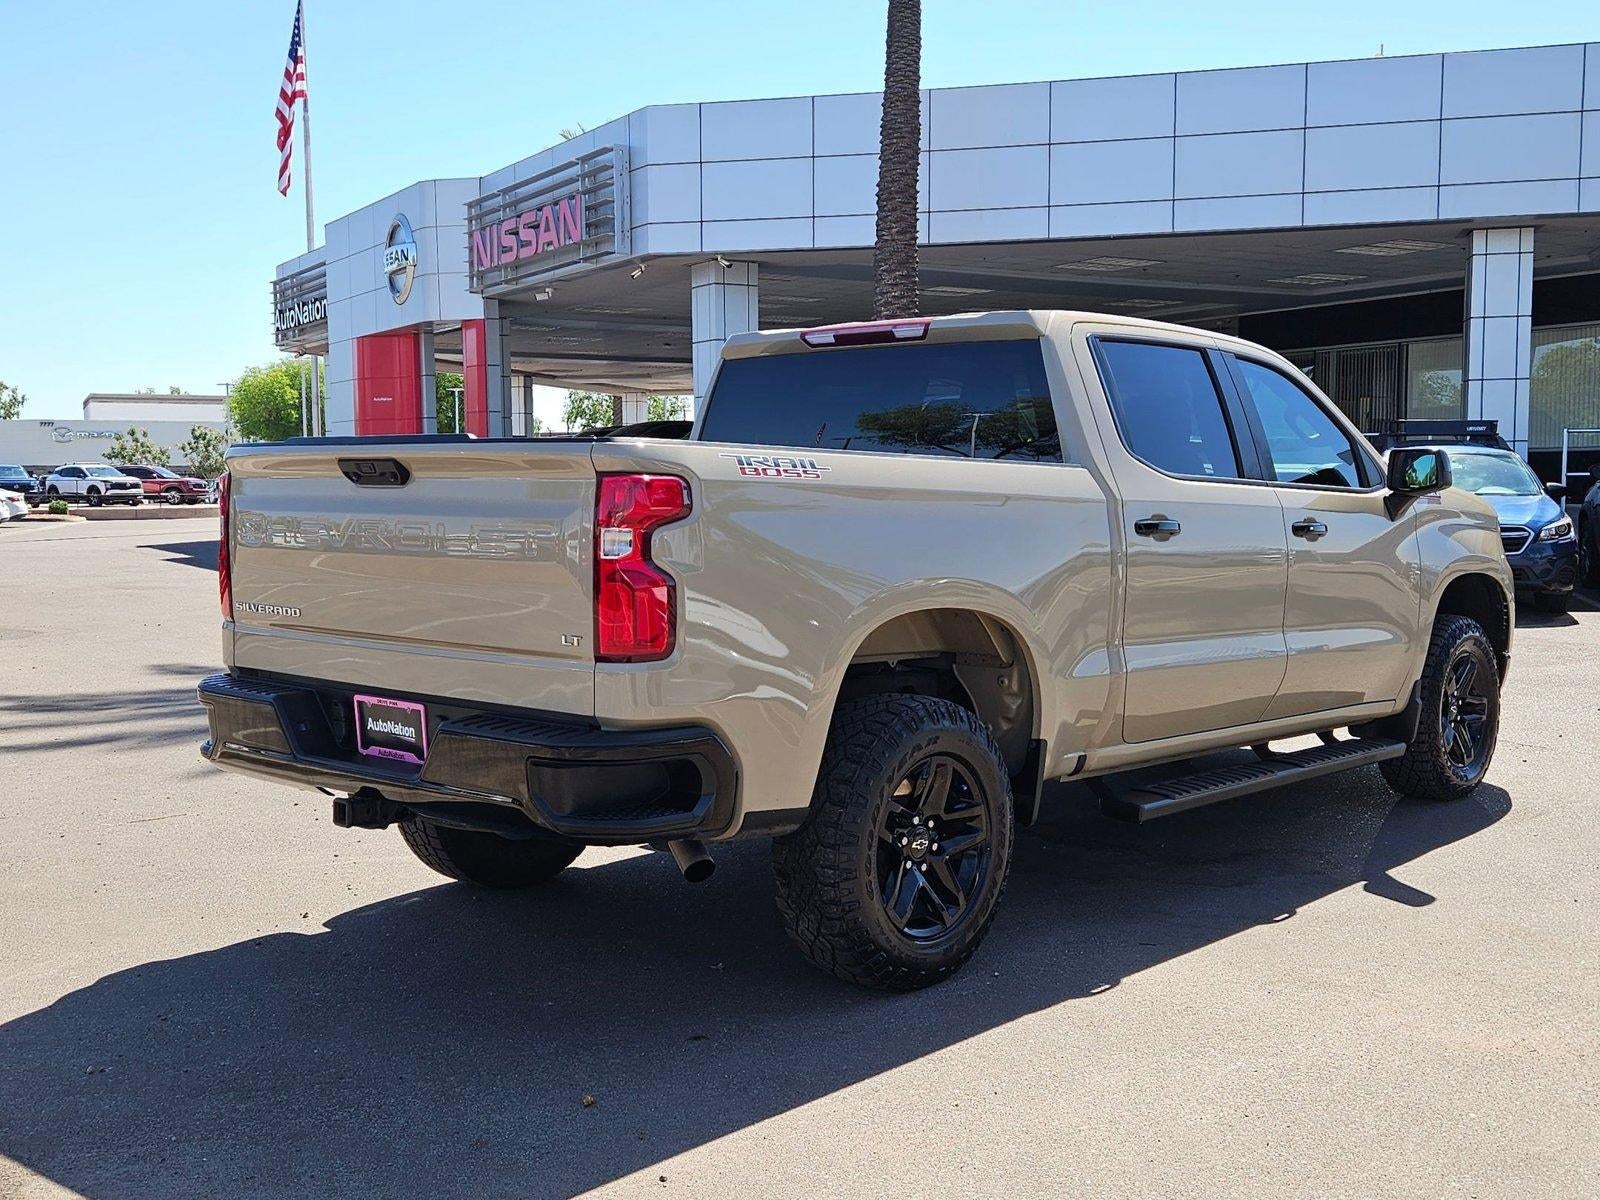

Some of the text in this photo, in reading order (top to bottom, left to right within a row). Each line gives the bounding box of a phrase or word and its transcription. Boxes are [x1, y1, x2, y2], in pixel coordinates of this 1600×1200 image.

[473, 194, 582, 272] NISSAN
[275, 298, 328, 331] AutoNation
[718, 453, 832, 472] TRAIL
[739, 466, 822, 480] BOSS
[236, 510, 556, 559] CHEVROLET
[235, 602, 302, 618] SILVERADO
[561, 634, 583, 647] LT
[367, 717, 415, 738] AutoNation
[378, 749, 405, 760] AutoNation
